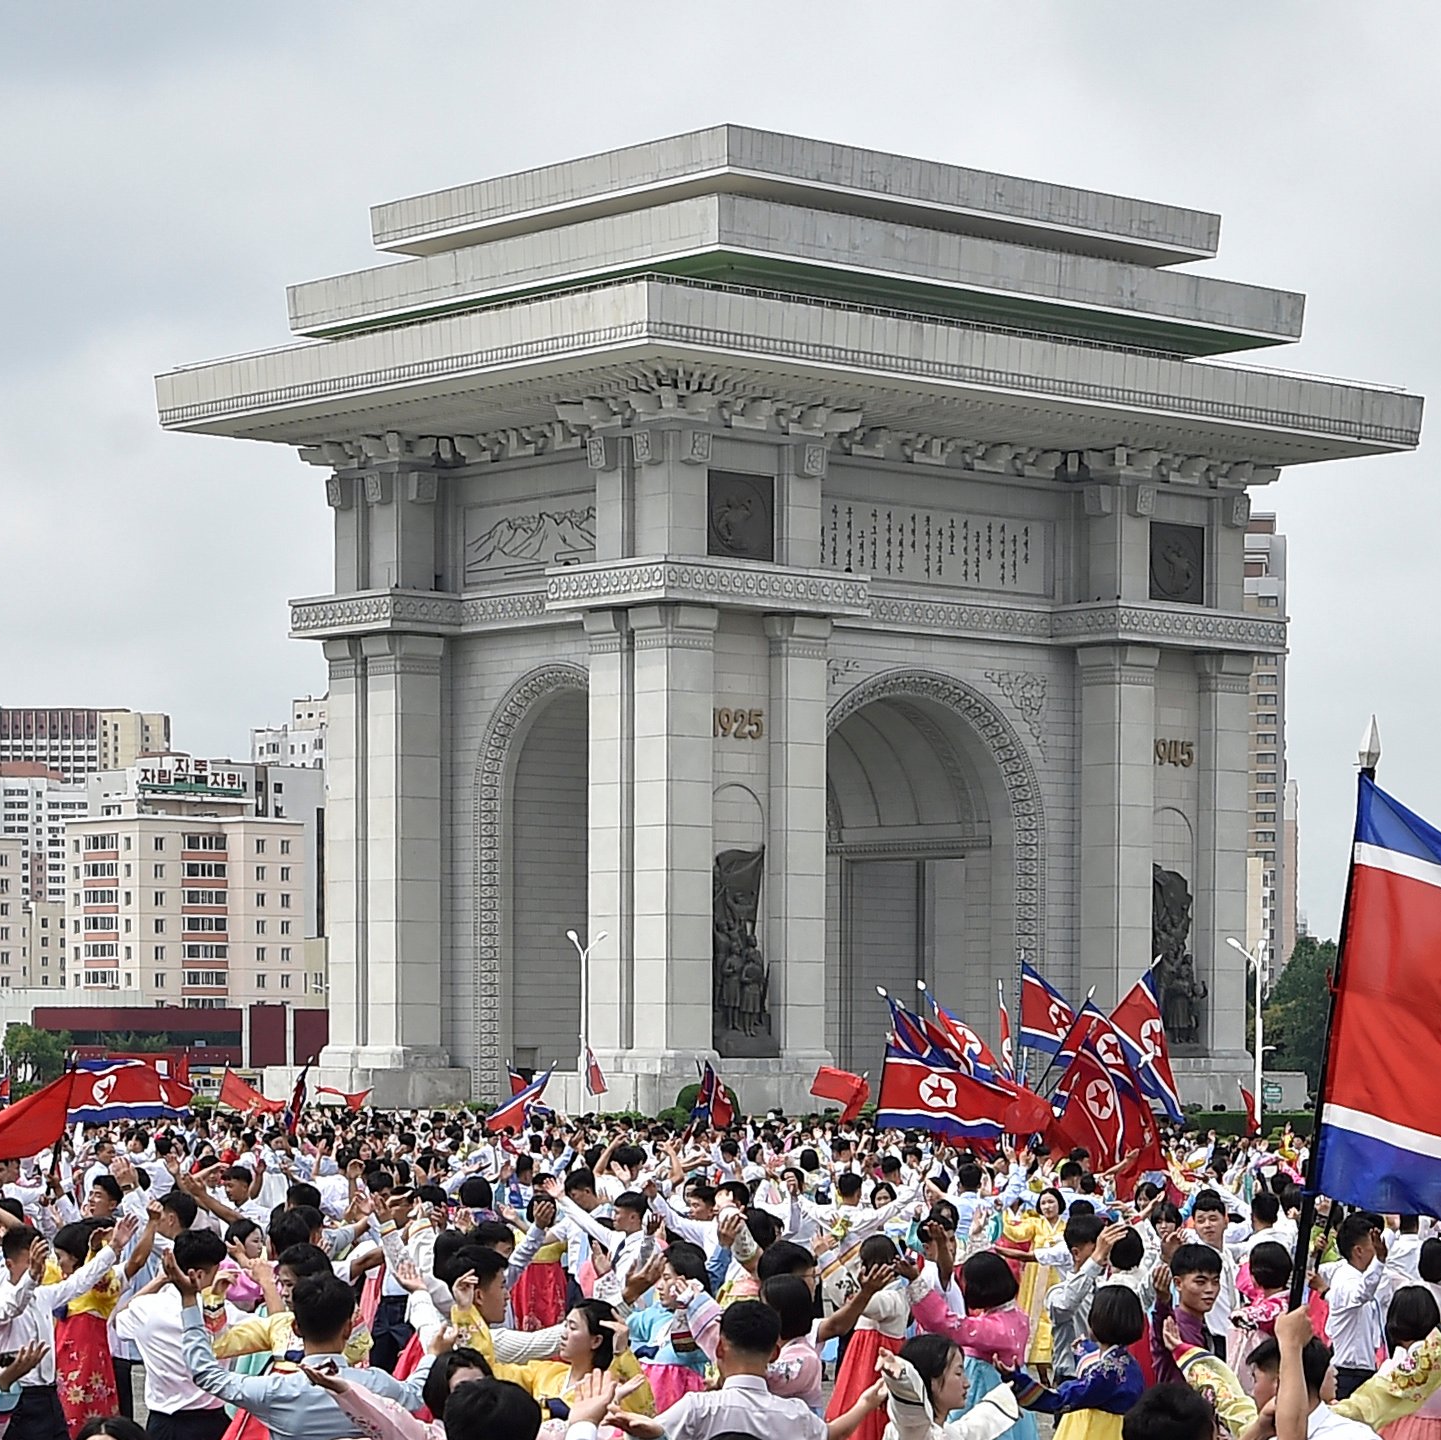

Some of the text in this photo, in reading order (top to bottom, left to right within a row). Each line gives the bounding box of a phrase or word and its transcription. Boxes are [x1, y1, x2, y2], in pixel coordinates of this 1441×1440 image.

[712, 707, 764, 739] 1925
[175, 758, 208, 774] 자주
[140, 768, 241, 788] 자립 자위
